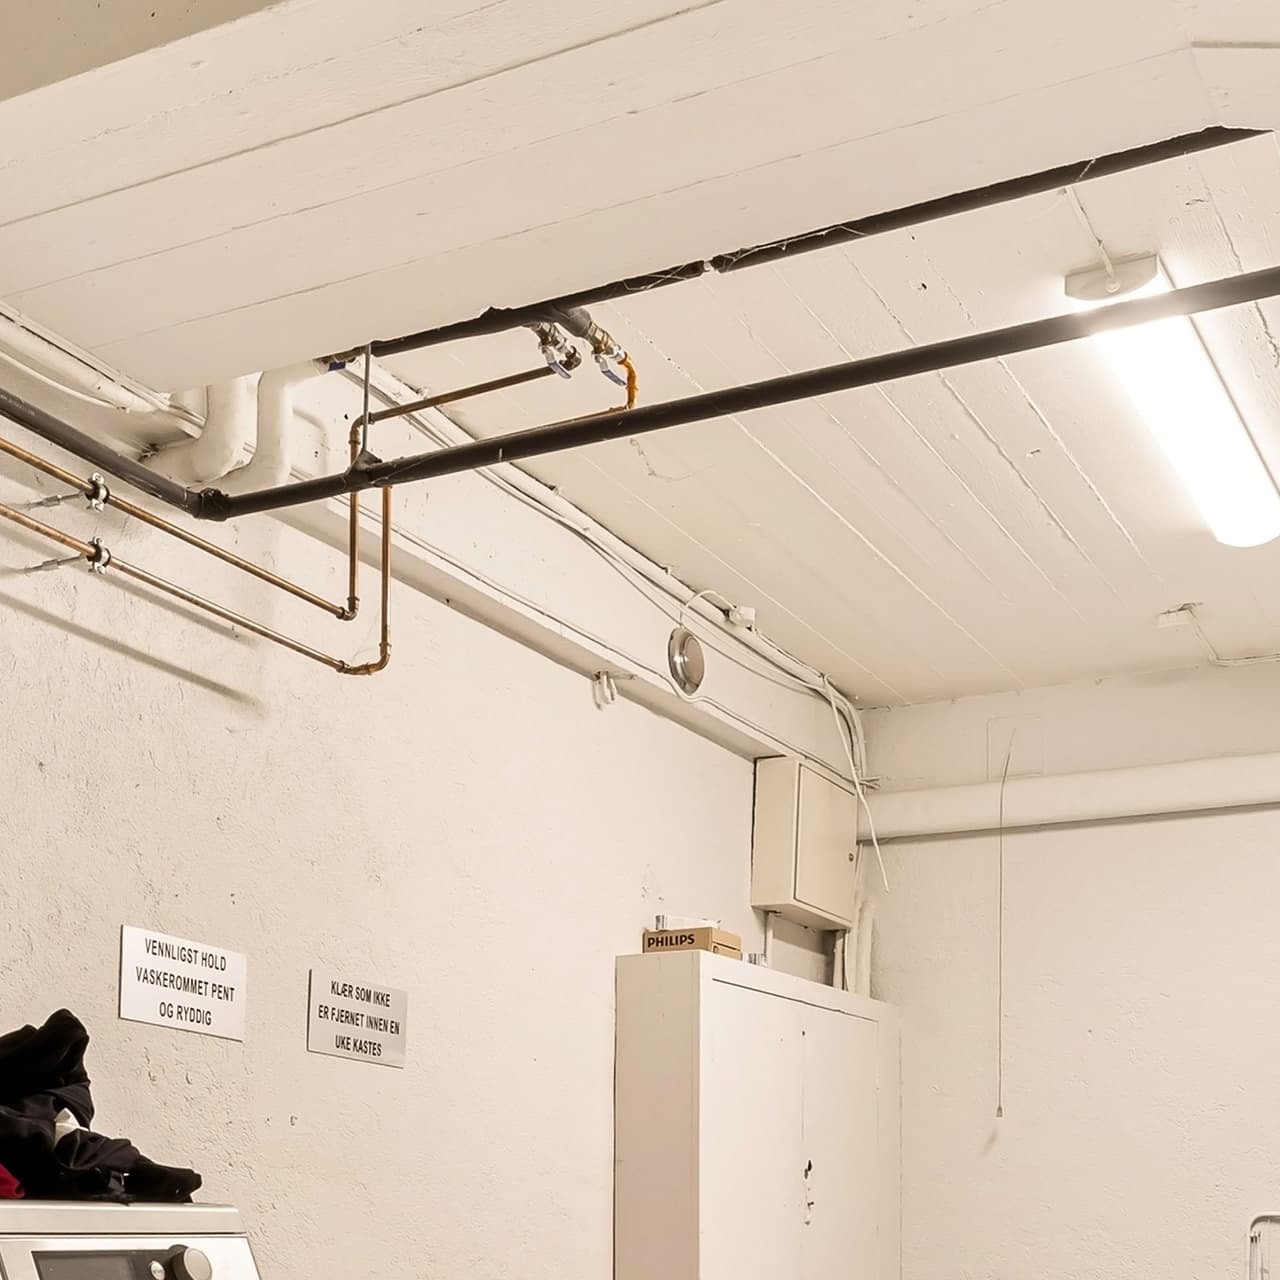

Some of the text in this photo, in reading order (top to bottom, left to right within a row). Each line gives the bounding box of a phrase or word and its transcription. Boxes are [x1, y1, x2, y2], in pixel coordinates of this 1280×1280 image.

[144, 937, 227, 971] VENNLIGST HOLD
[647, 933, 695, 948] PHILIPS
[136, 966, 235, 1002] VASKEROMMET PENT
[330, 980, 391, 1008] KLÆR SOM IKKE
[159, 1001, 212, 1026] OG RYDDIG
[318, 1004, 400, 1035] ER FJERNET INNEN EN
[335, 1034, 382, 1056] UKE KASTES
